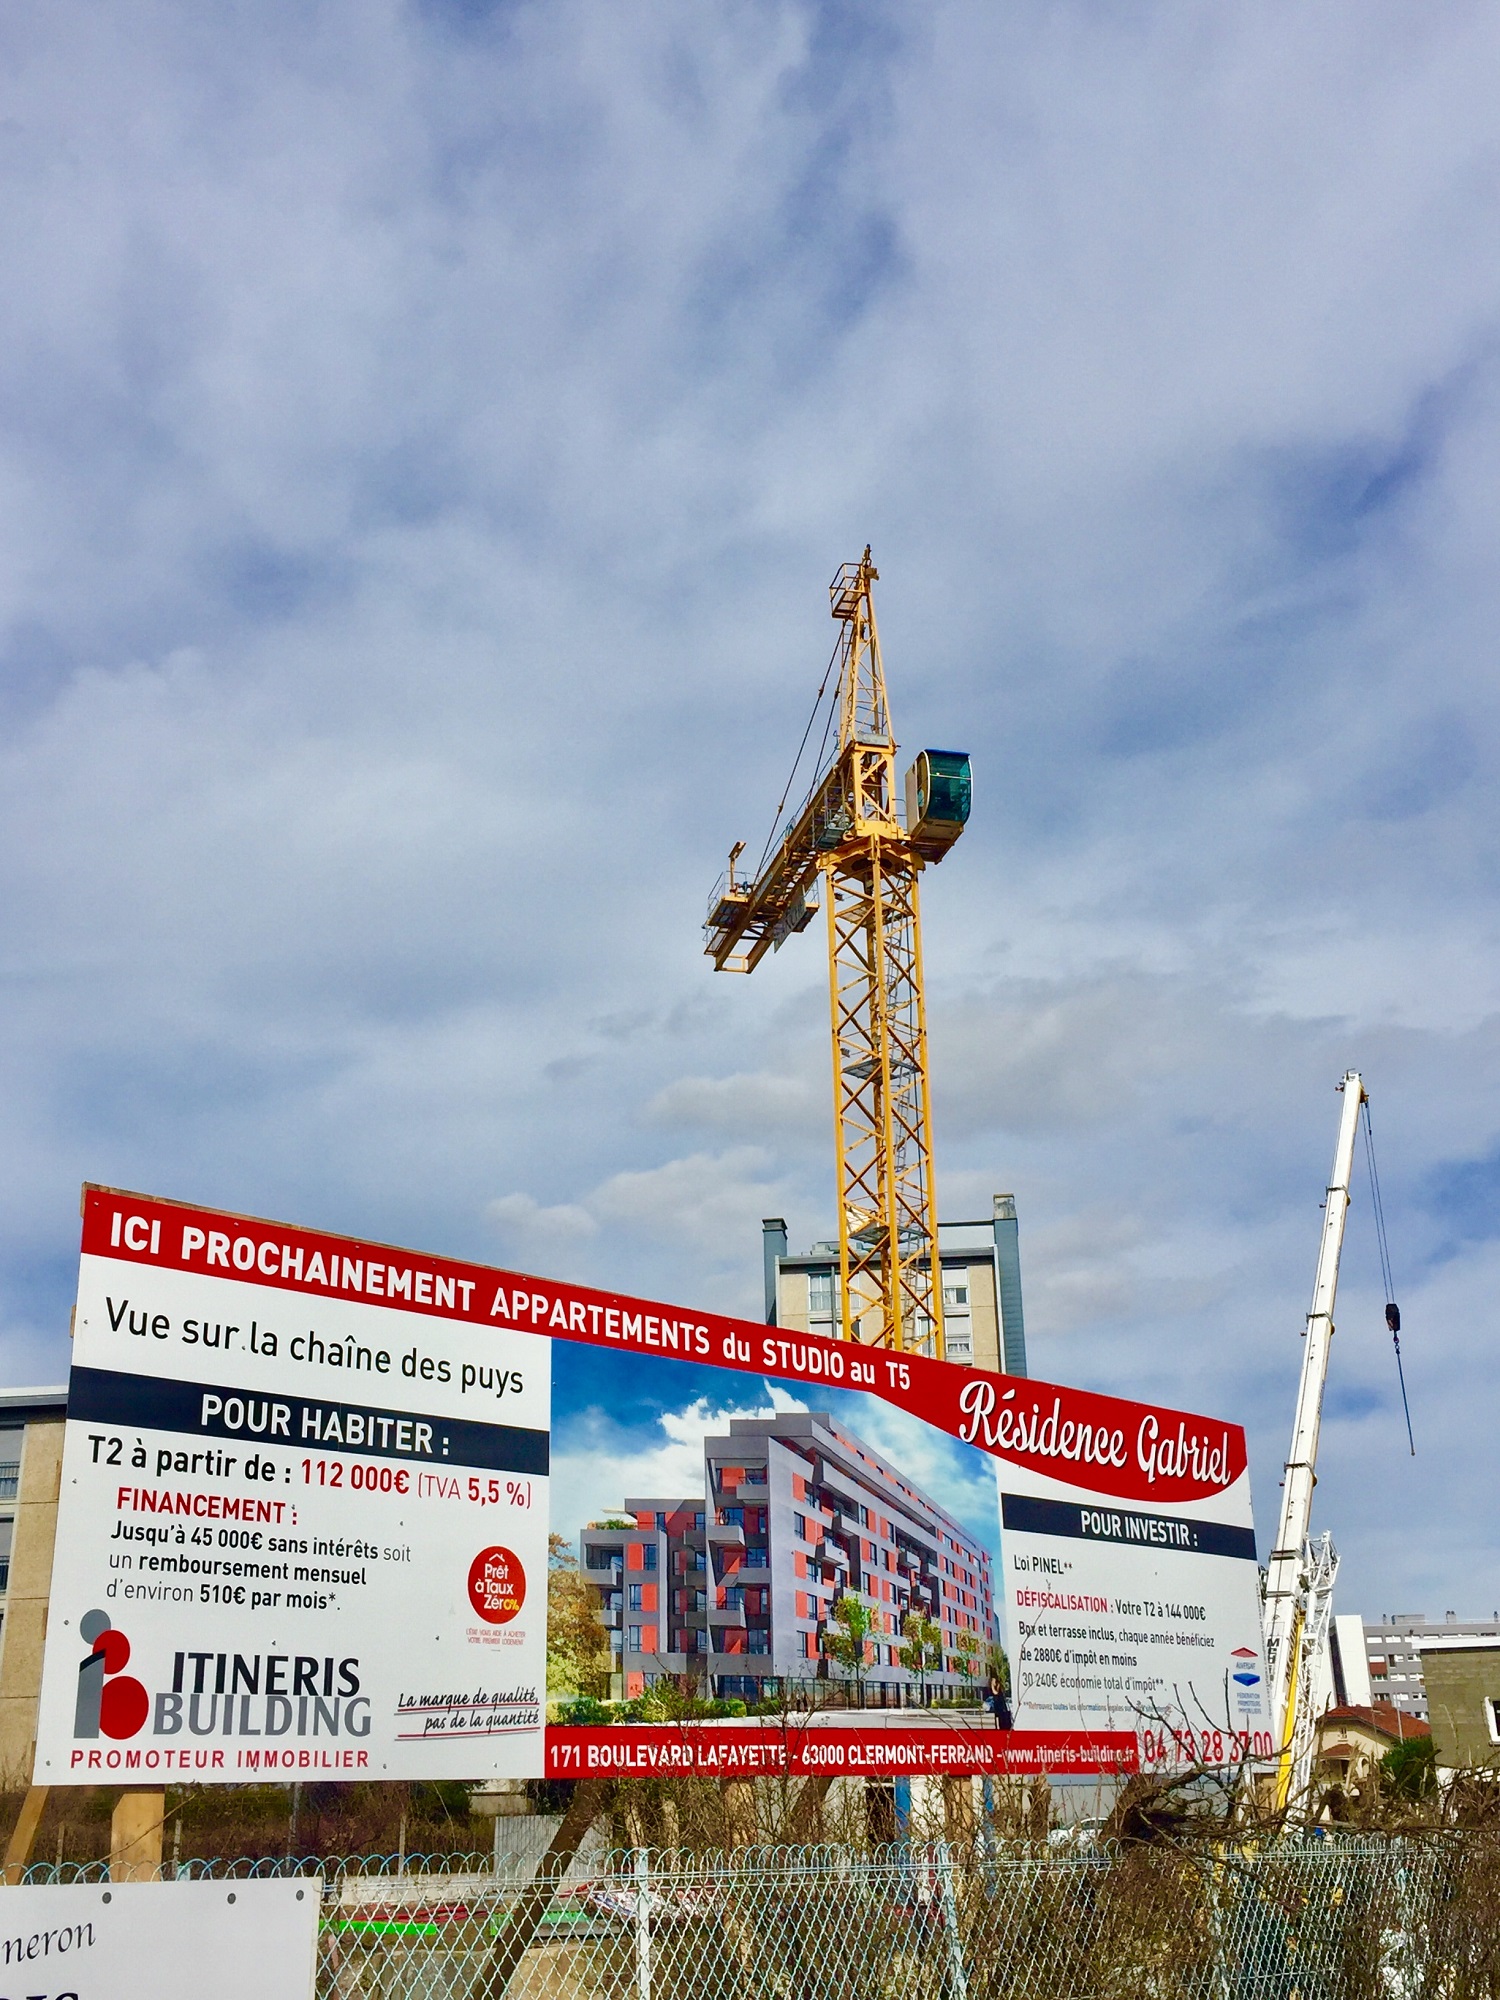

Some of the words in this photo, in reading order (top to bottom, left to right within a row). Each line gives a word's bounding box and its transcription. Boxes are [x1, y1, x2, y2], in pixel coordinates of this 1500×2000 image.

[110, 1211, 161, 1255] ICI
[181, 1225, 476, 1312] PROCHAINEMENT
[489, 1286, 711, 1355] APPARTEMENTS
[722, 1331, 751, 1363] du
[762, 1338, 845, 1379] STUDIO
[849, 1361, 876, 1385] au
[885, 1360, 912, 1390] T5
[105, 1296, 171, 1340] Vue
[181, 1318, 241, 1351] sur
[249, 1320, 279, 1358] la
[289, 1330, 392, 1375] chaîne
[401, 1347, 453, 1384] des
[461, 1362, 525, 1400] puys
[200, 1393, 293, 1438] POUR
[301, 1406, 435, 1455] HABITER
[957, 1379, 1128, 1468] Résidence
[1136, 1413, 1232, 1486] Gabriel
[87, 1434, 124, 1467] T2
[131, 1436, 148, 1470] à
[155, 1448, 239, 1479] partir
[243, 1453, 277, 1482] de
[300, 1458, 344, 1489] 112
[349, 1463, 411, 1496] 000€
[417, 1472, 462, 1501] (TVA
[466, 1477, 500, 1508] 5,5
[506, 1481, 532, 1510] %)
[115, 1486, 287, 1526] FINANCEMENT
[110, 1520, 187, 1548] Jusqu'à
[190, 1525, 213, 1548] 45
[217, 1528, 264, 1551] 000€
[267, 1536, 309, 1555] sans
[312, 1537, 380, 1560] intérêts
[382, 1543, 412, 1563] soit
[1080, 1509, 1123, 1538] POUR
[1124, 1514, 1191, 1547] INVESTIR
[108, 1553, 133, 1570] un
[138, 1553, 290, 1582] remboursement
[293, 1565, 368, 1586] mensuel
[474, 1577, 485, 1594] à
[484, 1578, 515, 1596] Taux
[484, 1562, 509, 1580] Prêt
[105, 1578, 195, 1603] d'environ
[198, 1583, 247, 1606] 510€
[250, 1591, 283, 1611] par
[1016, 1587, 1109, 1614] DÉFISCALISATION
[1115, 1598, 1143, 1617] Votre
[1143, 1600, 1157, 1618] T2
[1157, 1601, 1165, 1619] à
[1165, 1602, 1183, 1620] 144
[1183, 1604, 1207, 1622] 000€
[1038, 1623, 1048, 1638] et
[1048, 1624, 1088, 1640] terrasse
[1088, 1626, 1118, 1643] inclus,
[1118, 1628, 1149, 1646] chaque
[1150, 1630, 1176, 1646] année
[1175, 1630, 1215, 1649] bénéficiez
[1020, 1646, 1033, 1662] de
[1033, 1647, 1063, 1664] 2880€
[1064, 1648, 1098, 1668] d'impôt
[1099, 1653, 1110, 1666] en
[1111, 1652, 1139, 1667] moins
[171, 1650, 361, 1699] ITINERIS
[1021, 1672, 1034, 1688] 30
[1035, 1672, 1059, 1689] 240€
[1060, 1673, 1102, 1691] économie
[1103, 1675, 1124, 1691] total
[152, 1692, 373, 1739] BUILDING
[398, 1692, 418, 1708] La
[418, 1692, 471, 1714] marque
[472, 1686, 490, 1705] de
[491, 1686, 539, 1713] qualité,
[422, 1715, 448, 1738] pas
[449, 1710, 468, 1730] de
[469, 1709, 485, 1728] la
[485, 1708, 540, 1735] quantité
[70, 1748, 226, 1770] PROMOTEUR
[236, 1748, 370, 1770] IMMOBILIER
[550, 1744, 581, 1768] 171
[587, 1744, 694, 1768] BOULEVARD
[697, 1743, 787, 1767] LAFAYETTE
[801, 1744, 845, 1766] 63000
[847, 1743, 994, 1766] CLERMONT-FERRAND
[1201, 1729, 1224, 1763] 28
[1253, 1730, 1274, 1762] 00
